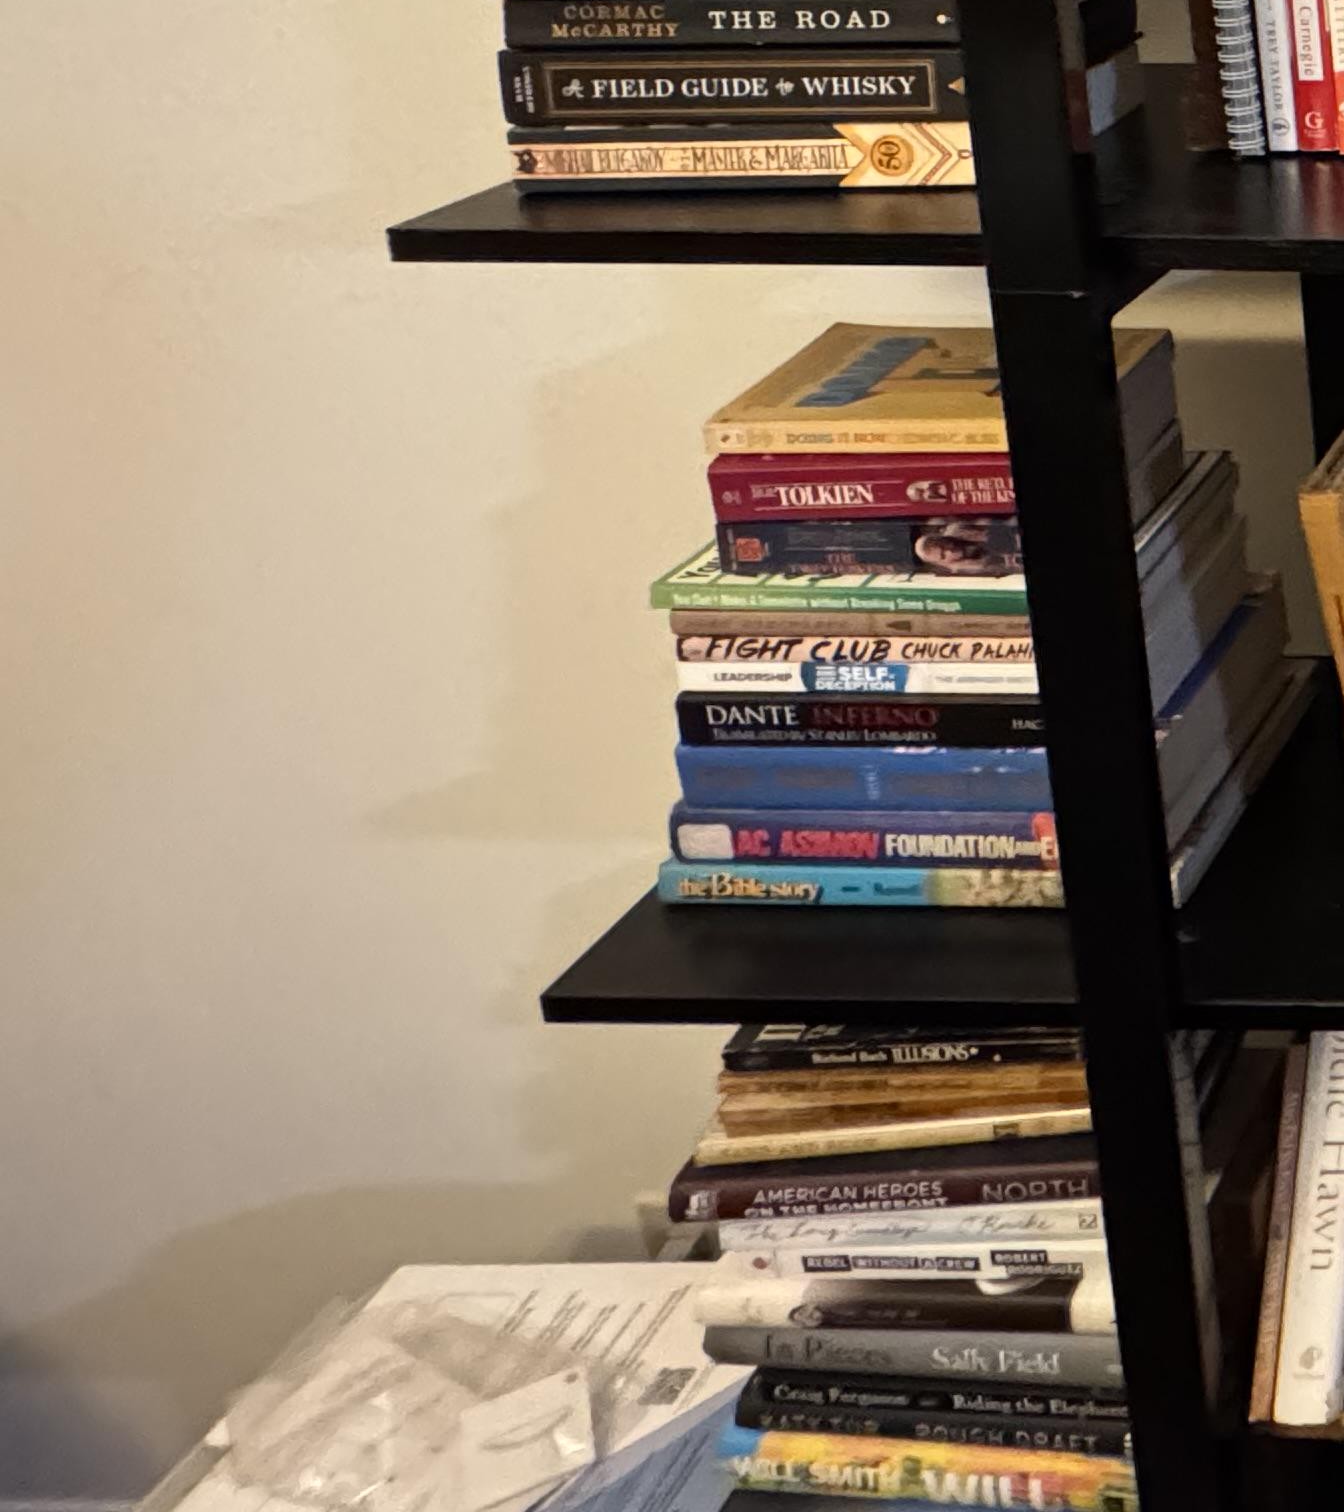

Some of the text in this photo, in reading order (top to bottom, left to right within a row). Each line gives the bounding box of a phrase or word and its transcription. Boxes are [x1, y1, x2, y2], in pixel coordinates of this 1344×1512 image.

[564, 5, 665, 21] CORMAC
[709, 10, 892, 30] THE ROAD
[551, 22, 680, 40] McCARTHY
[591, 76, 917, 98] FIELD GUIDE WHISKY
[775, 484, 874, 506] TOLKIEN
[705, 637, 961, 661] FIGHT CLUB CHUCK
[706, 705, 798, 726] DANTE
[885, 834, 1015, 859] FOUNDATION
[754, 1179, 1088, 1203] AMERICAN NORTH
